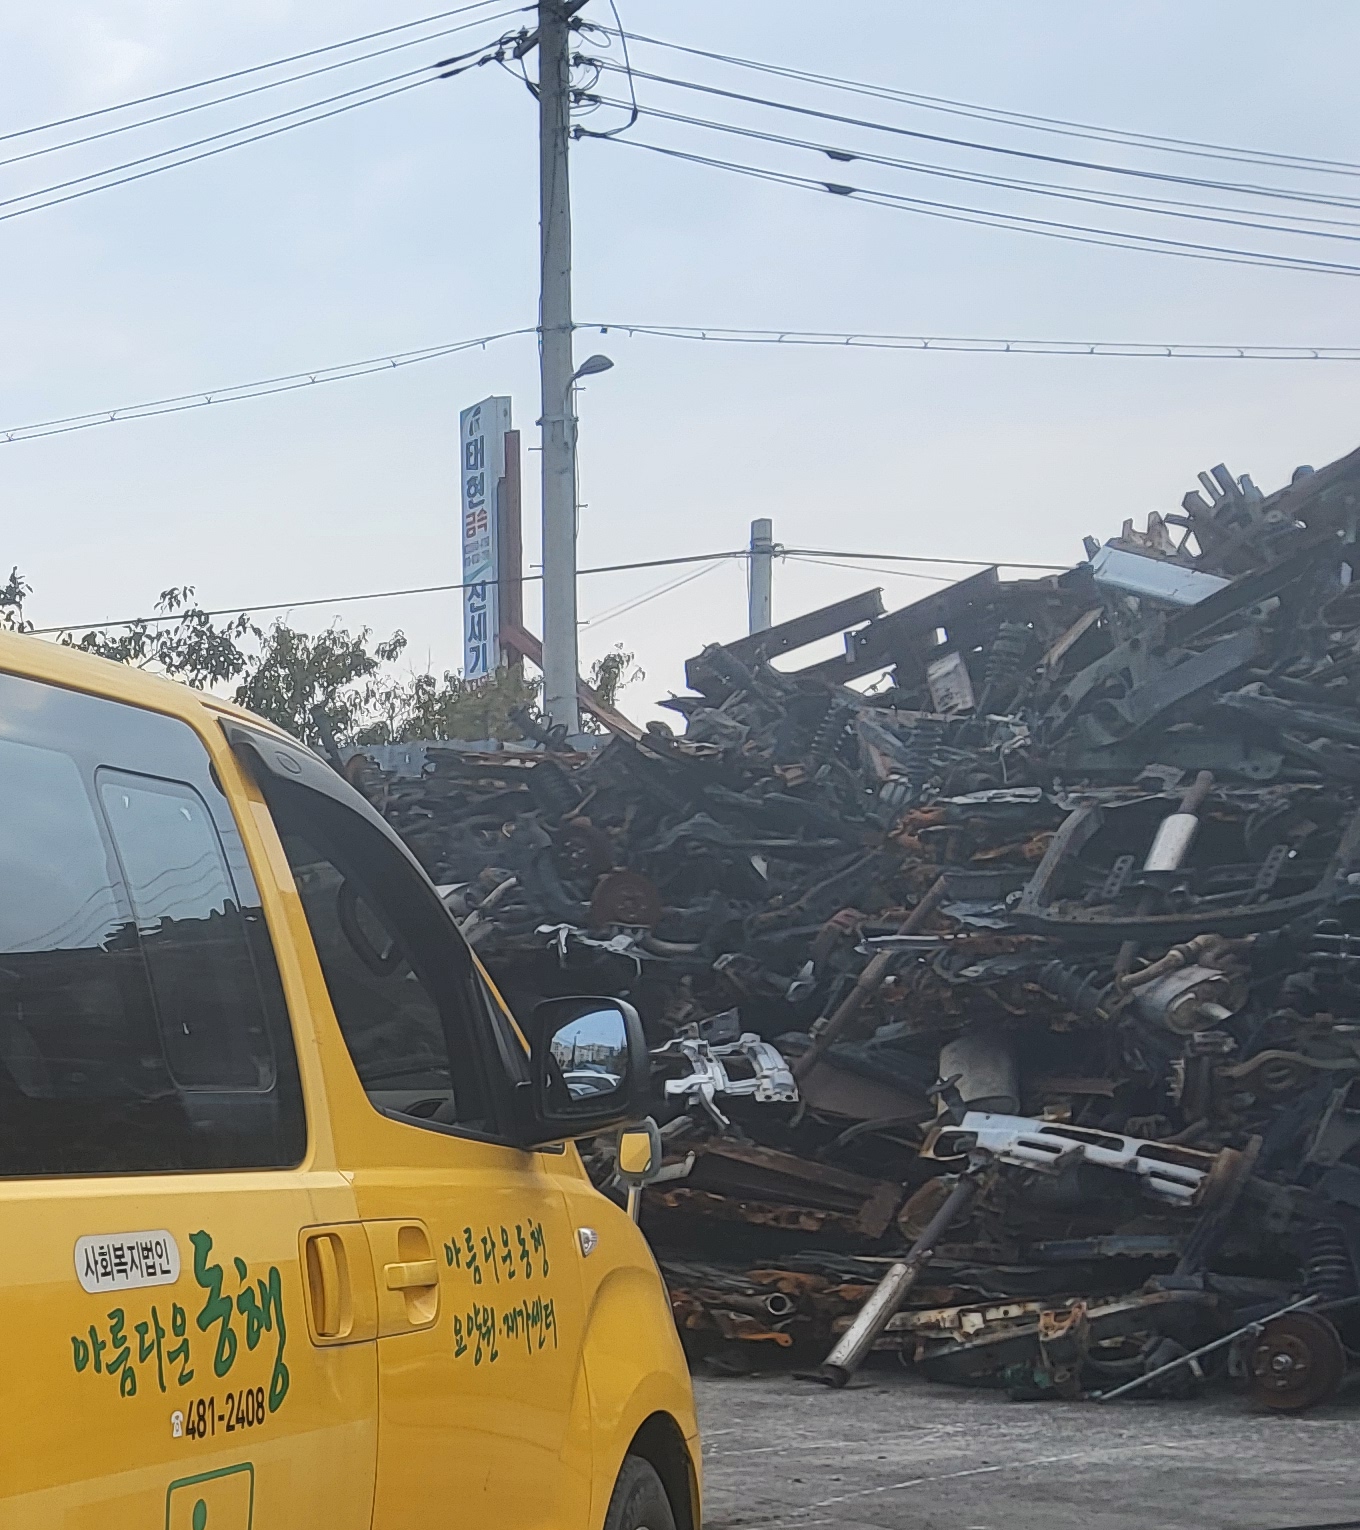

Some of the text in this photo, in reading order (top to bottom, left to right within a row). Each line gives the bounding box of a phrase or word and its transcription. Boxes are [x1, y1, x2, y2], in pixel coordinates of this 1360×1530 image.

[84, 1238, 172, 1284] 사회복지법인
[71, 1230, 290, 1413] 아름다운 동행
[185, 1386, 265, 1440] 481-2408
